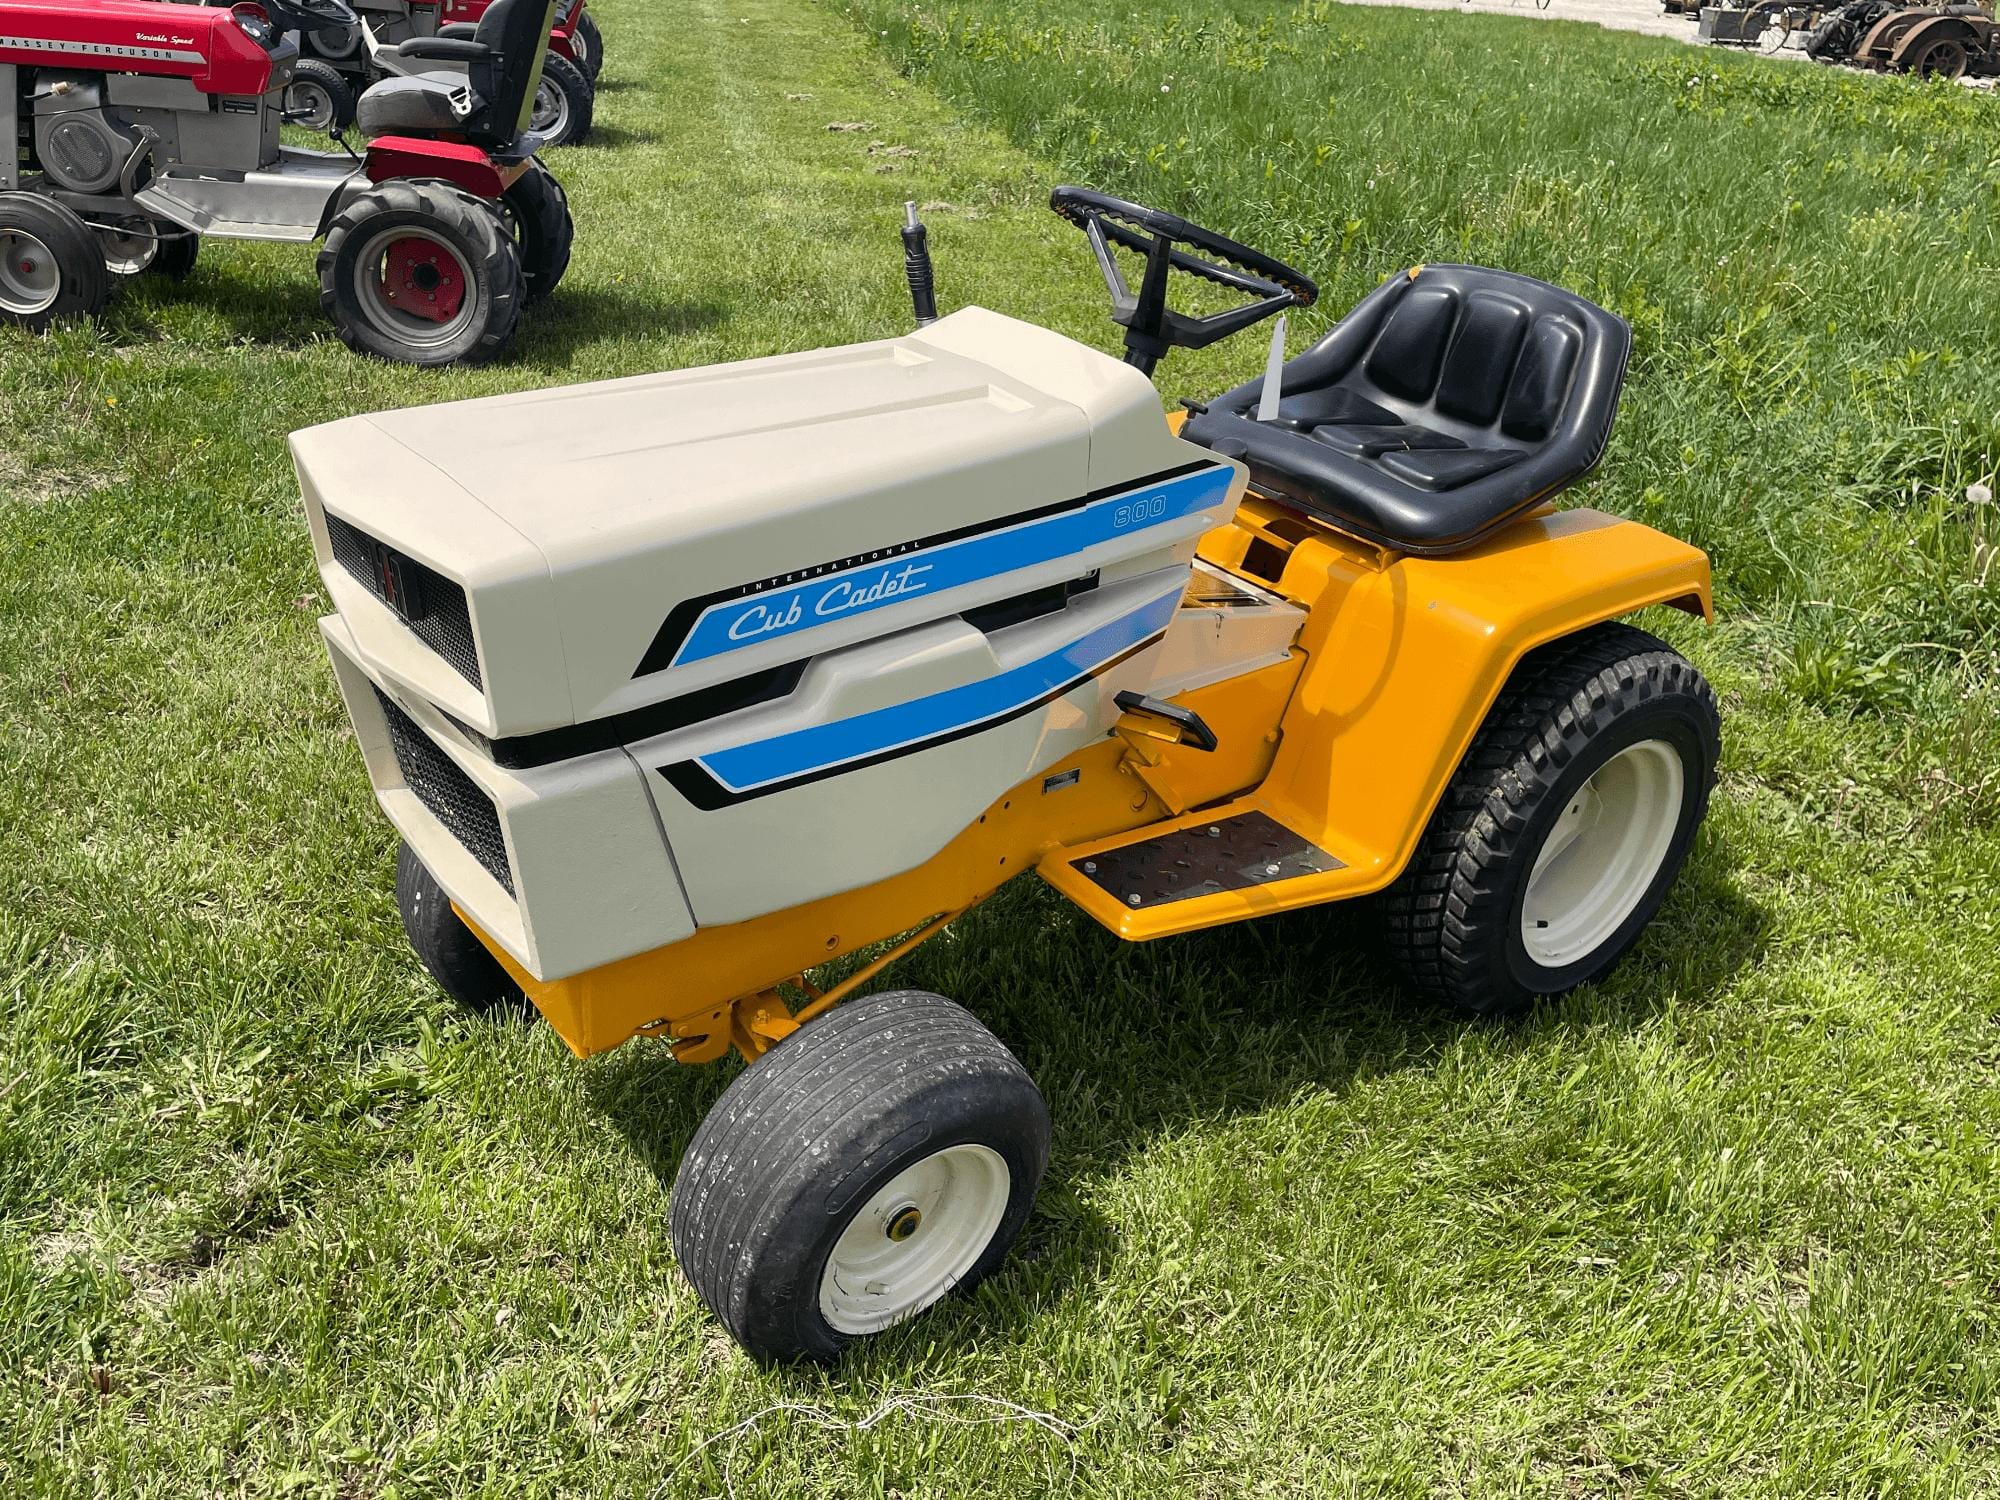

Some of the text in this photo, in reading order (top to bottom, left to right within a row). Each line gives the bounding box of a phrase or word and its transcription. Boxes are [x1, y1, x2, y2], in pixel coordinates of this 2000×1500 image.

[136, 32, 194, 45] Variable Speed
[1113, 494, 1167, 528] 800
[742, 541, 920, 594] INTERNATIONAL
[728, 564, 934, 641] Cub Cadet
